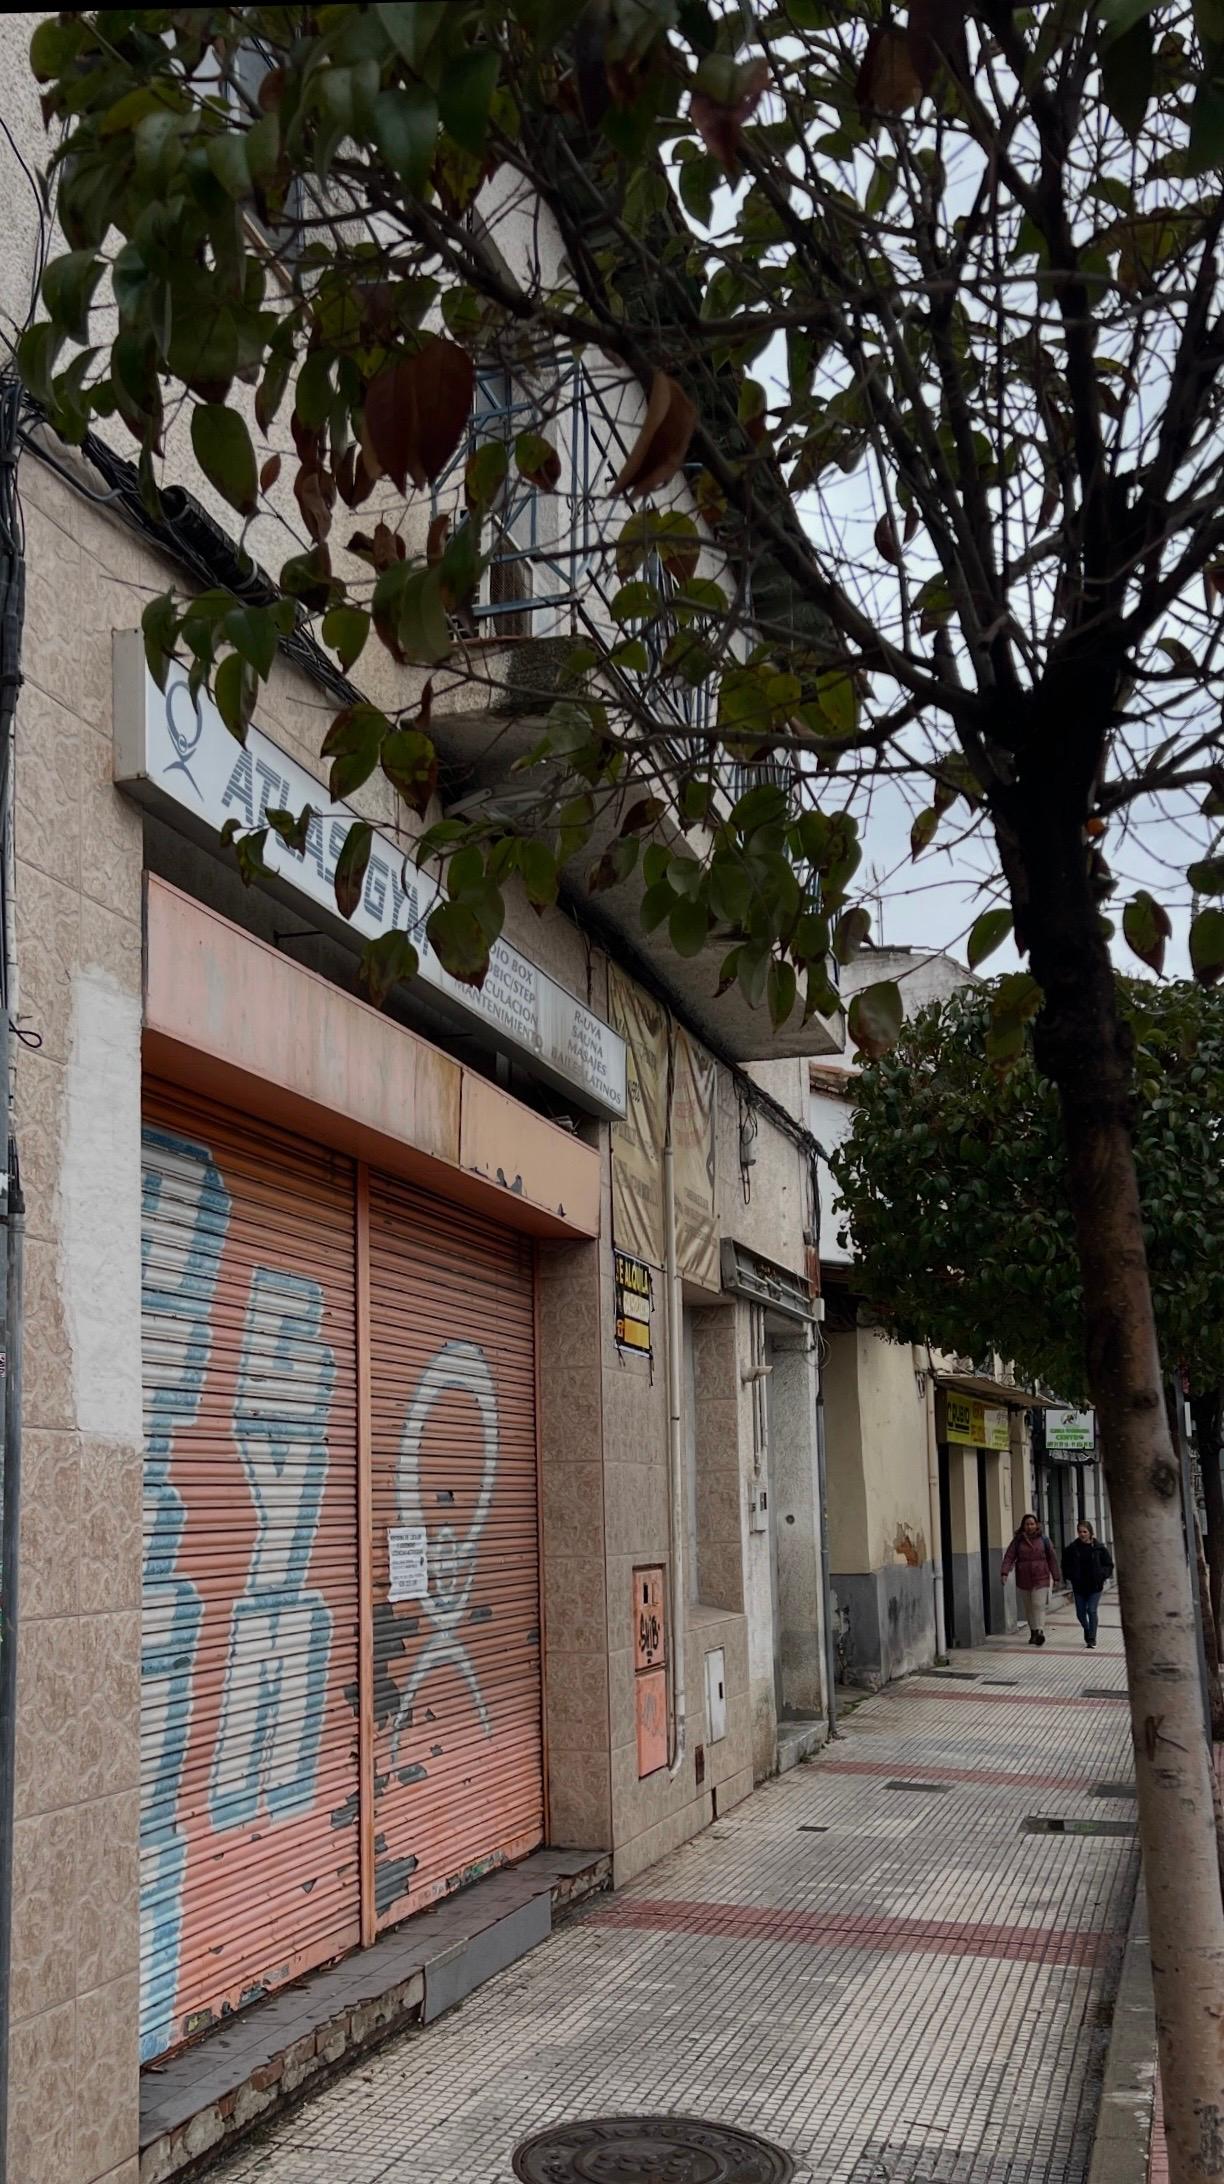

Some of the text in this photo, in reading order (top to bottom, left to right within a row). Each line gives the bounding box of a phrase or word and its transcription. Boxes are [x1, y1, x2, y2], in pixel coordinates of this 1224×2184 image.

[511, 959, 533, 984] BOX
[574, 1010, 602, 1039] R-UVA
[572, 1025, 604, 1057] SAUNA
[567, 1039, 607, 1076] MASAJES
[586, 1070, 621, 1105] LATINOS
